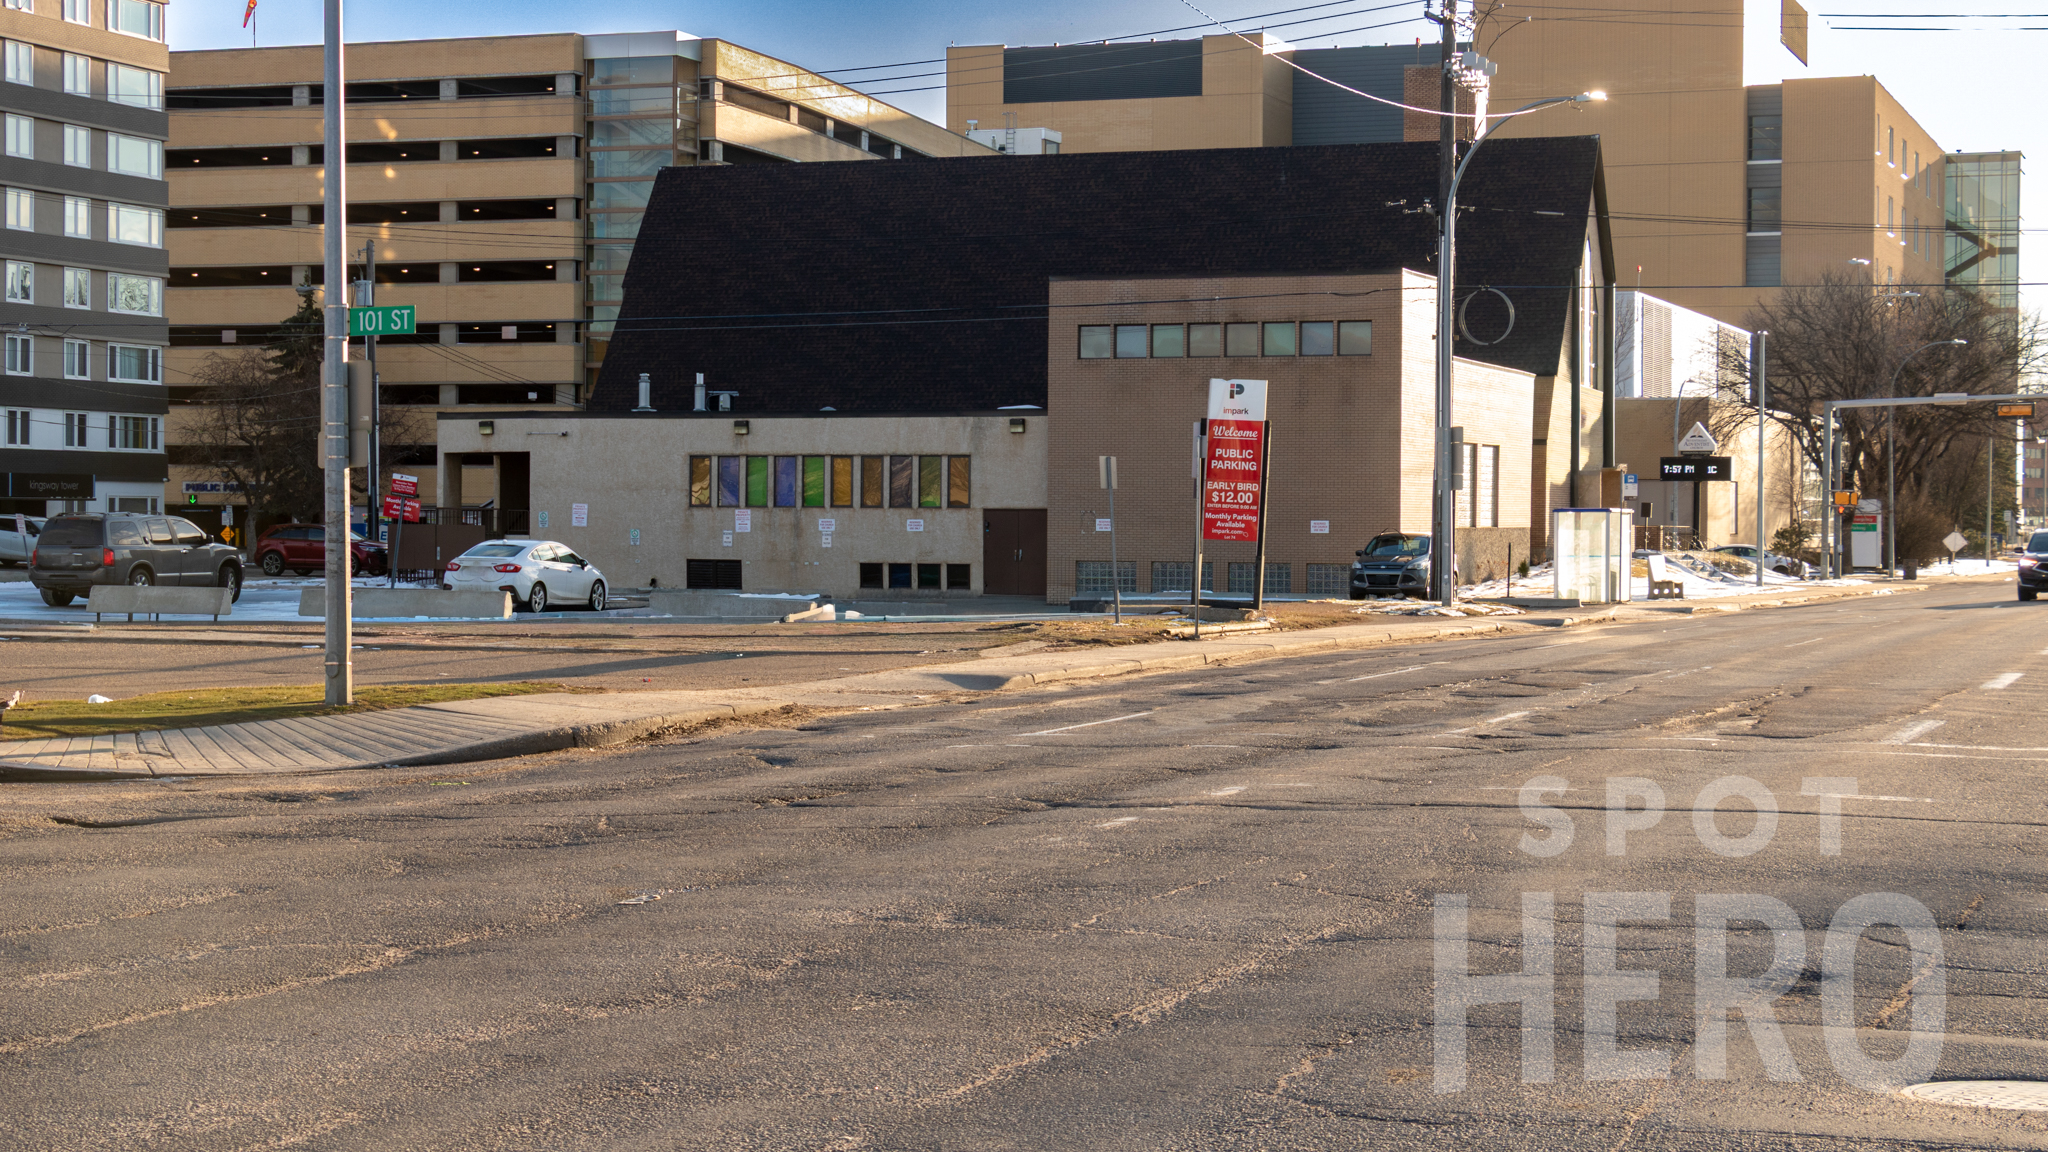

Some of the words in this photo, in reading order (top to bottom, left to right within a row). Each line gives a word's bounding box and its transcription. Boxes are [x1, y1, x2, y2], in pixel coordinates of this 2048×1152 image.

[359, 310, 382, 332] 101
[391, 309, 411, 331] ST
[1223, 406, 1249, 416] impark
[1213, 425, 1259, 438] Welcome
[1215, 448, 1254, 459] PUBLIC
[1211, 460, 1257, 471] PARKING
[1663, 465, 1682, 474] 7:57
[1684, 465, 1695, 474] PM
[1706, 465, 1718, 474] 1C
[29, 480, 60, 492] kingsway
[61, 481, 79, 490] tower
[185, 483, 220, 492] PUBLIC
[1207, 481, 1236, 490] EARLY
[1237, 482, 1259, 491] BIRD
[1212, 491, 1253, 504] $12.00
[1205, 512, 1232, 521] Monthly
[1233, 513, 1257, 522] Parking
[1216, 520, 1246, 528] Available
